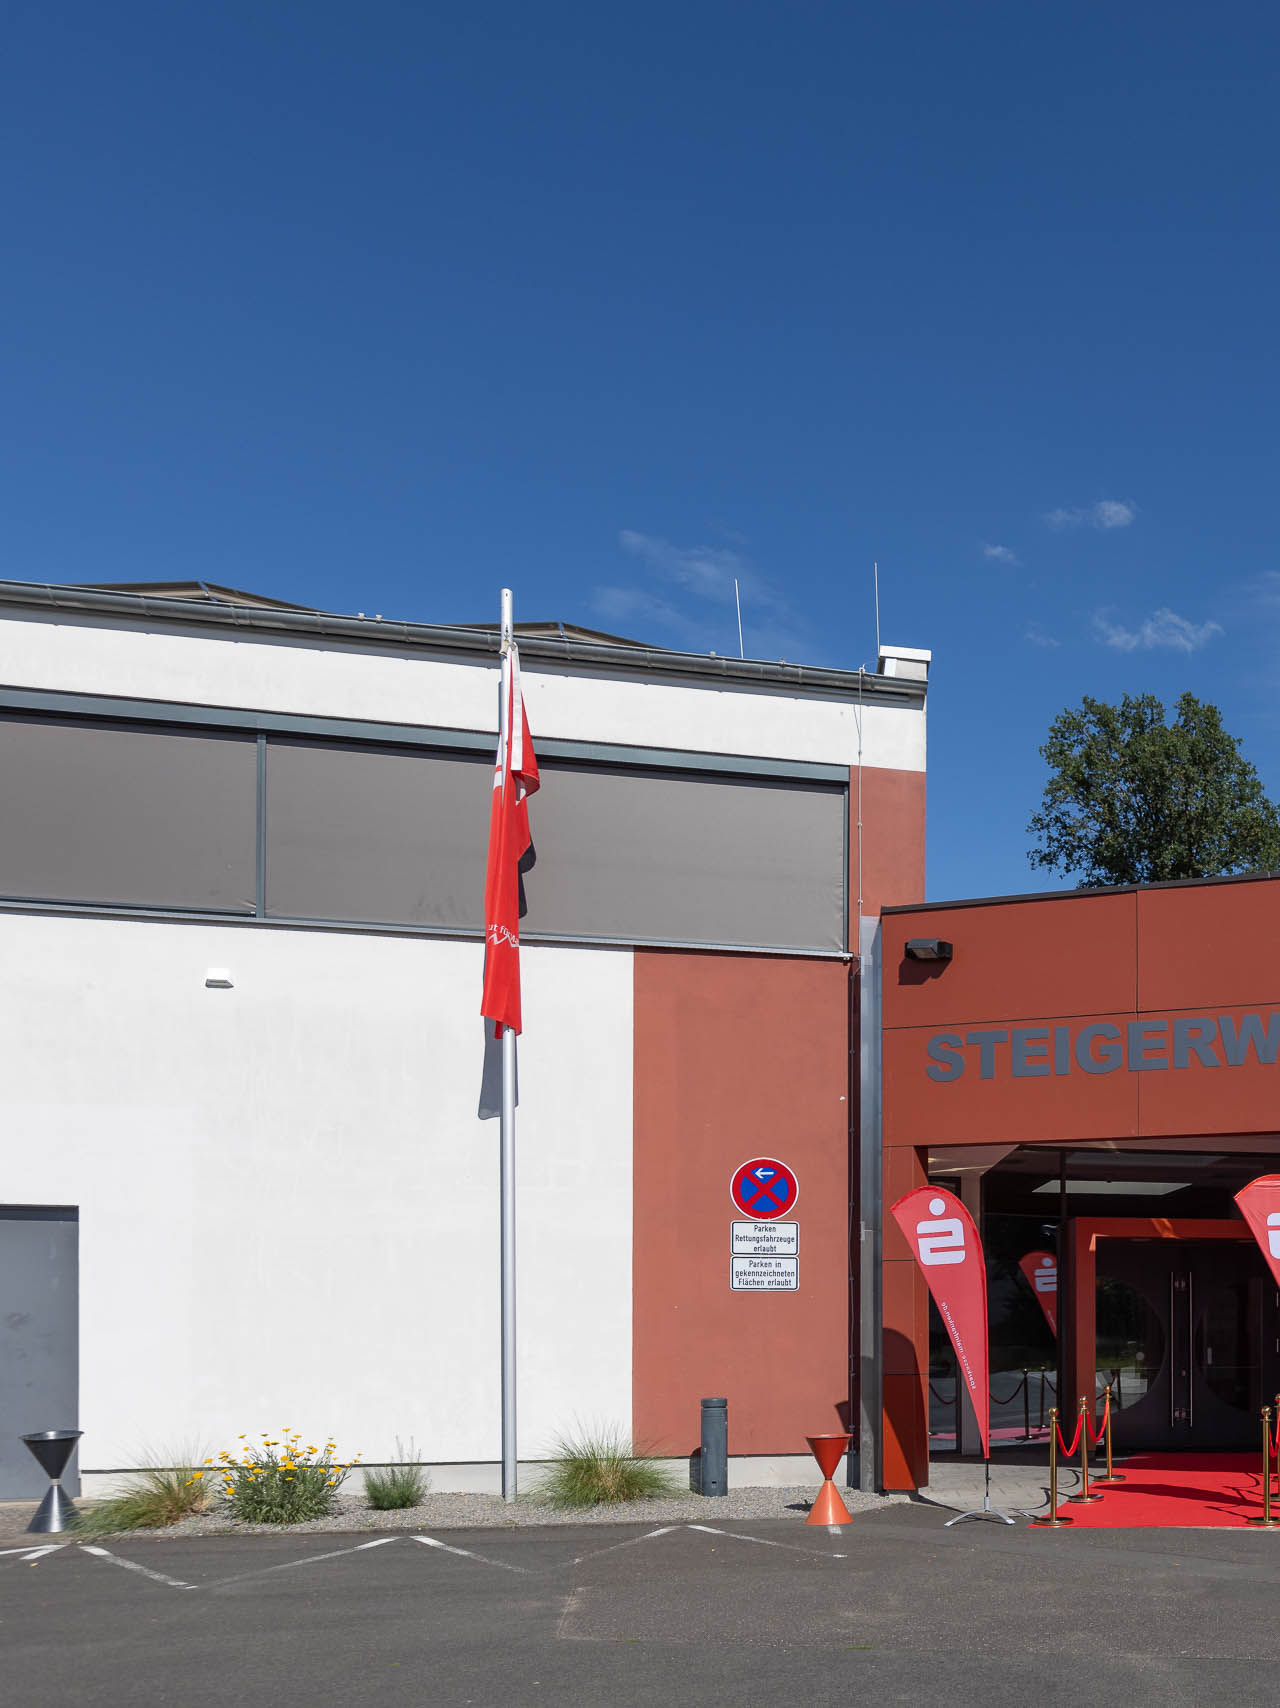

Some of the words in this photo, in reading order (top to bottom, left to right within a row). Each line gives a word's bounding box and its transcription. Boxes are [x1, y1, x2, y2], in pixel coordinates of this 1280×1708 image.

[735, 1235, 795, 1244] Rettungsfahrzeuge
[735, 1269, 795, 1278] gekennzeichneten
[738, 1278, 765, 1286] Flächen
